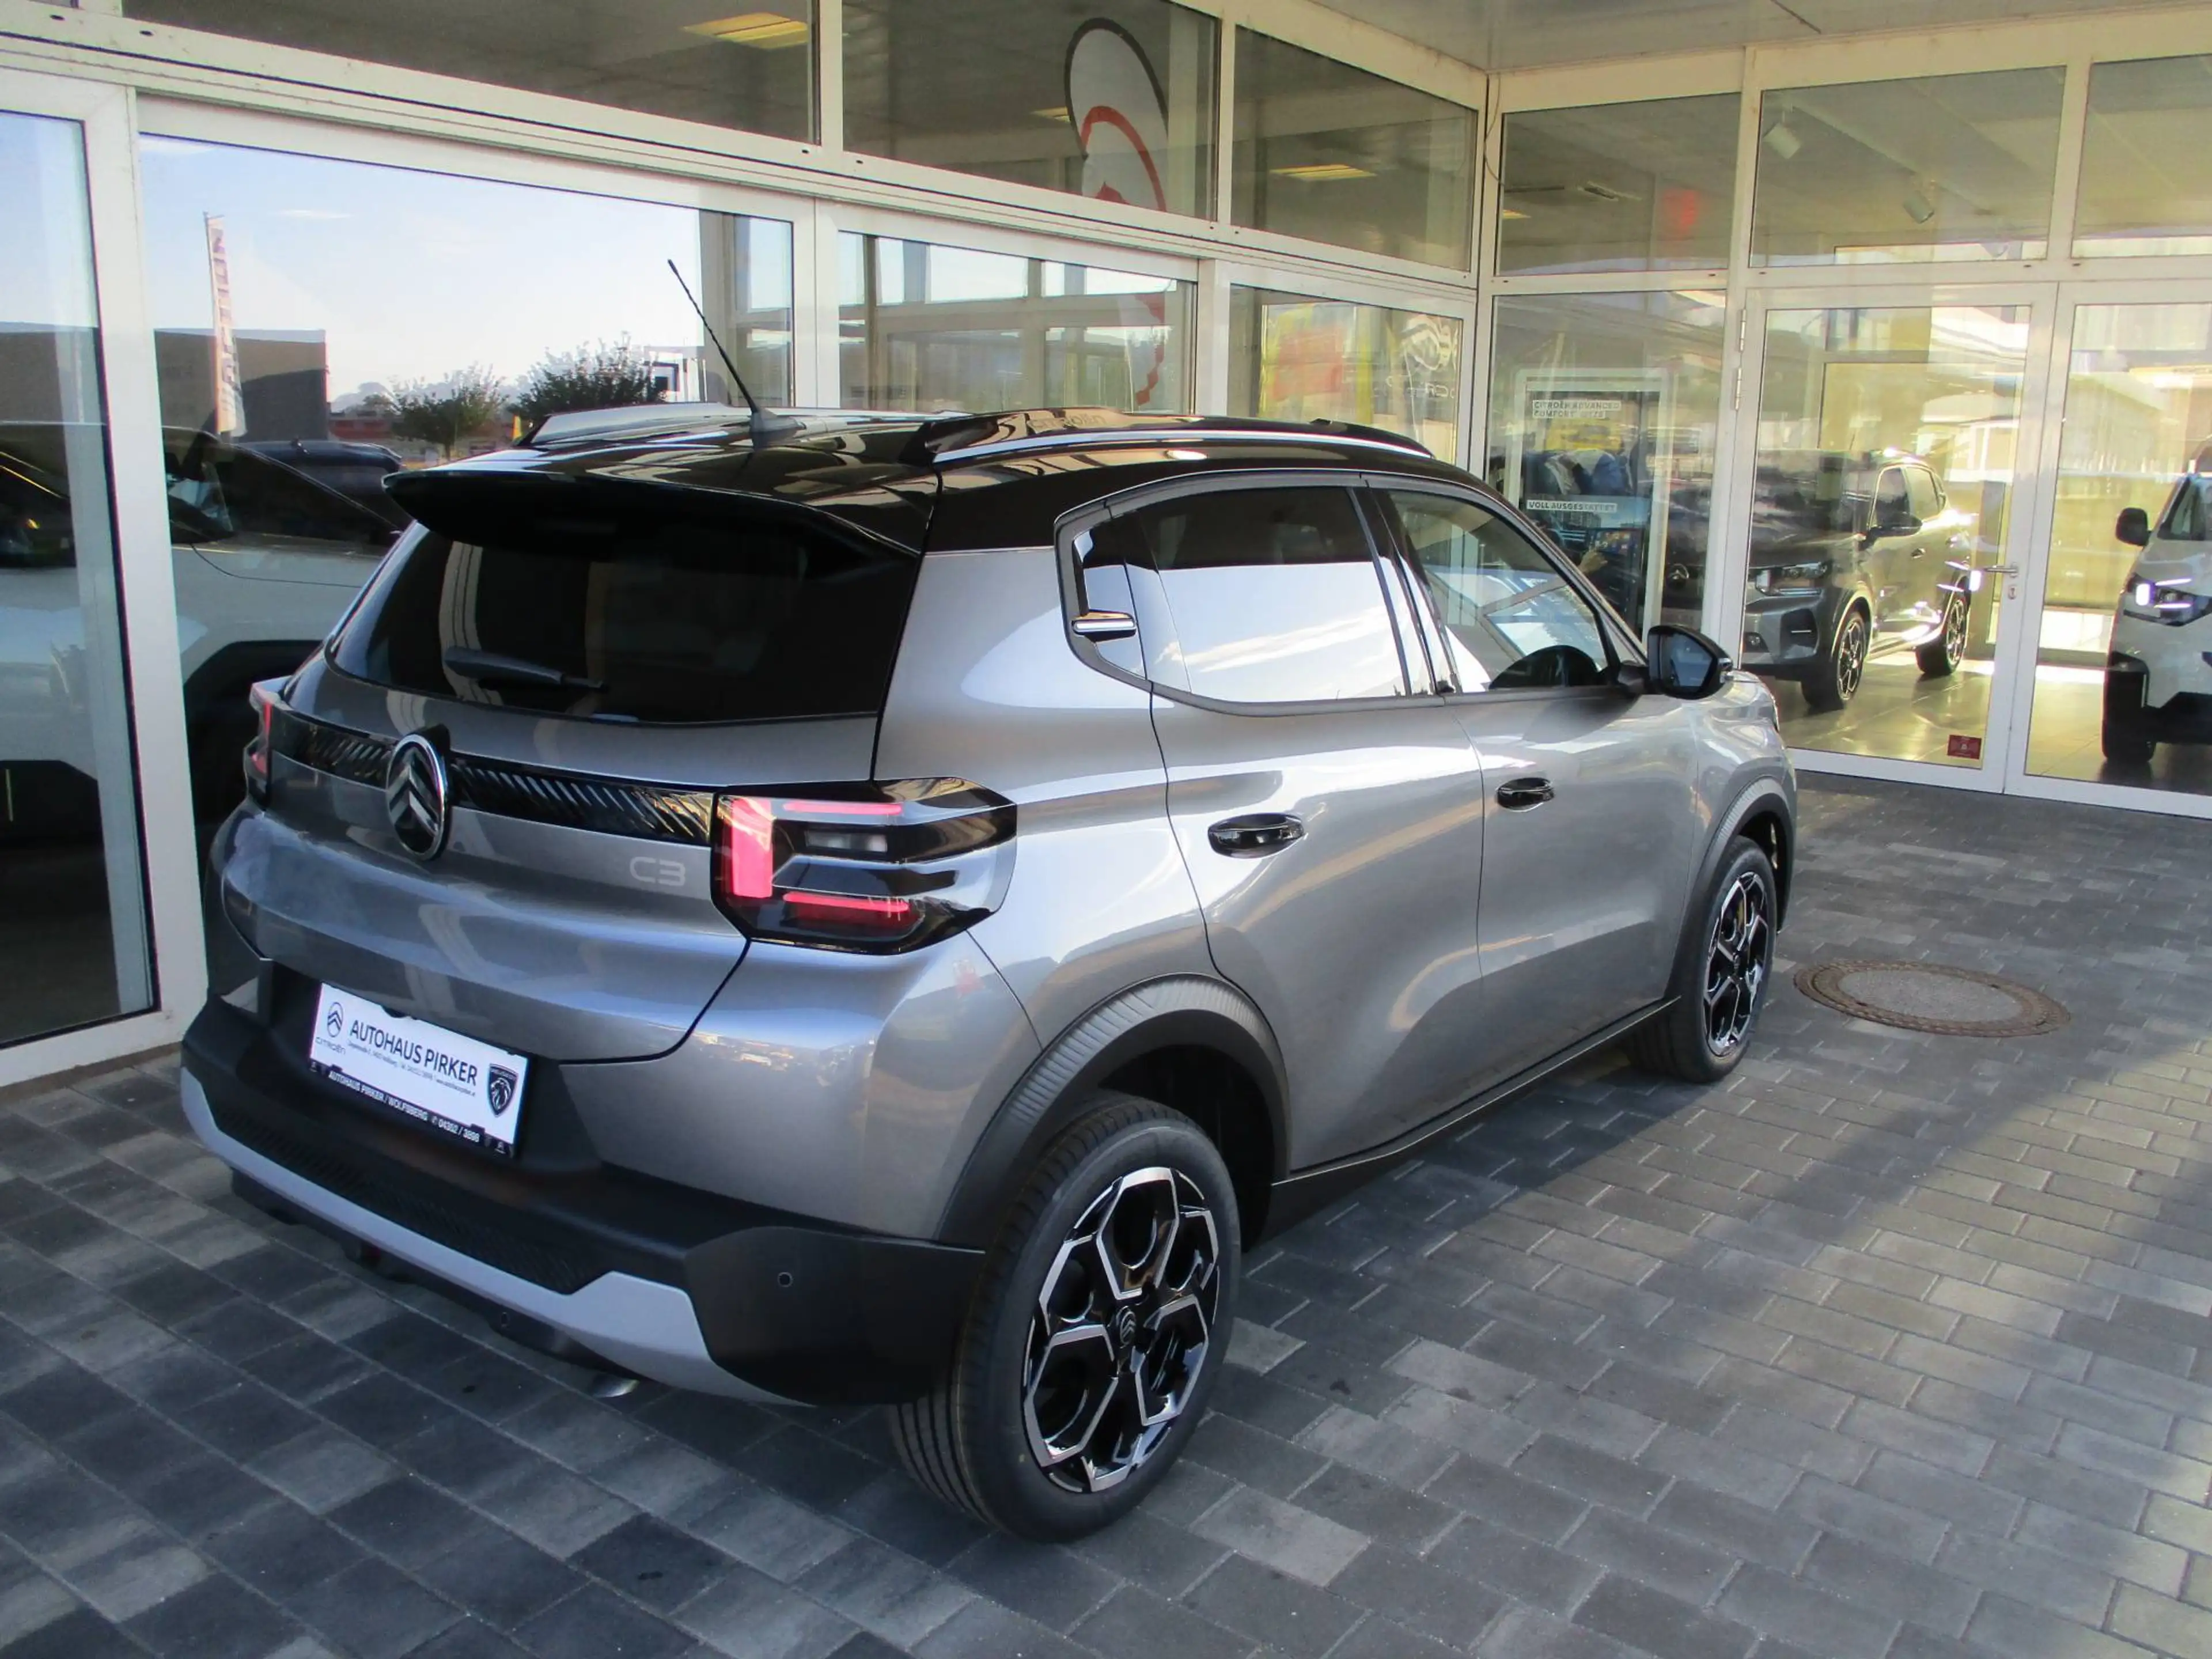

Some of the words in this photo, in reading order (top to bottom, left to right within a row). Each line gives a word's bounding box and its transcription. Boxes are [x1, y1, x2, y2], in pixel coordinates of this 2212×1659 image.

[630, 856, 685, 886] C3
[350, 1020, 422, 1064] AUTOHAUS
[424, 1048, 478, 1086] PIRKER
